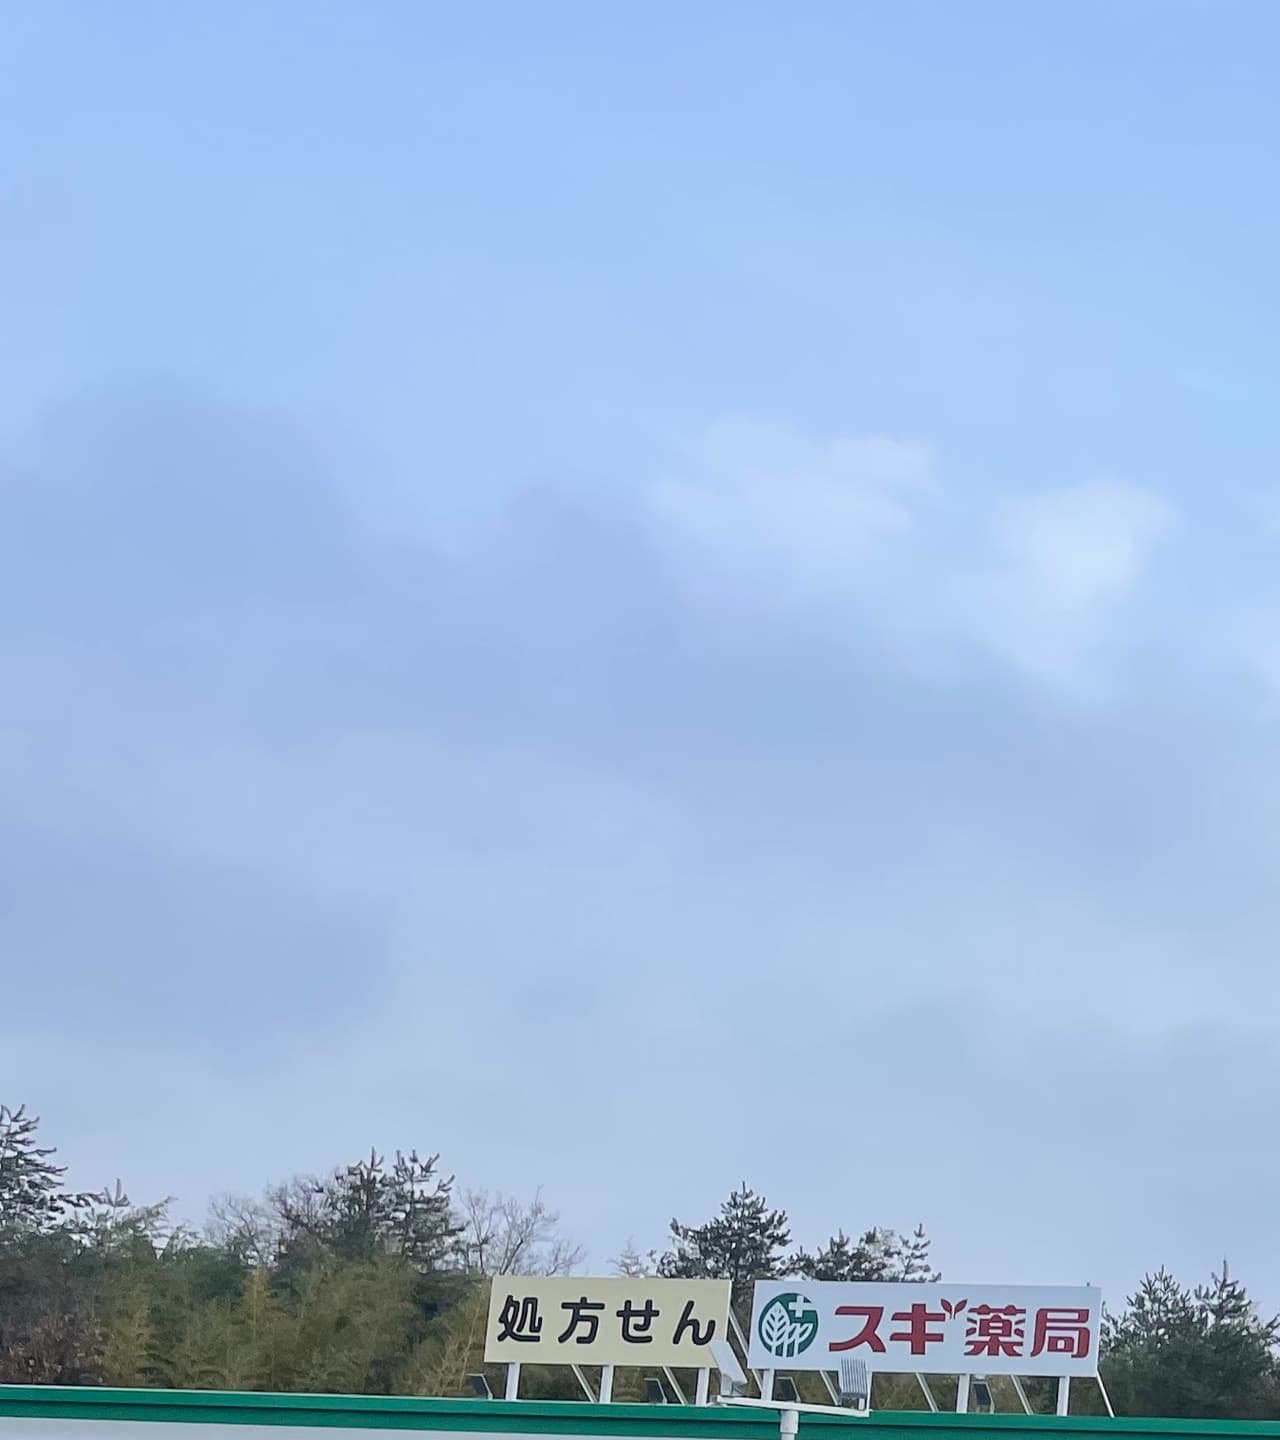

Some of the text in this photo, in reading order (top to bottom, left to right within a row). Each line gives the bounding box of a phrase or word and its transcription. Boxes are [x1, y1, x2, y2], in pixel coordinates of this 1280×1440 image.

[497, 1295, 716, 1346] 処方せん
[828, 1298, 1092, 1359] スギ薬局
